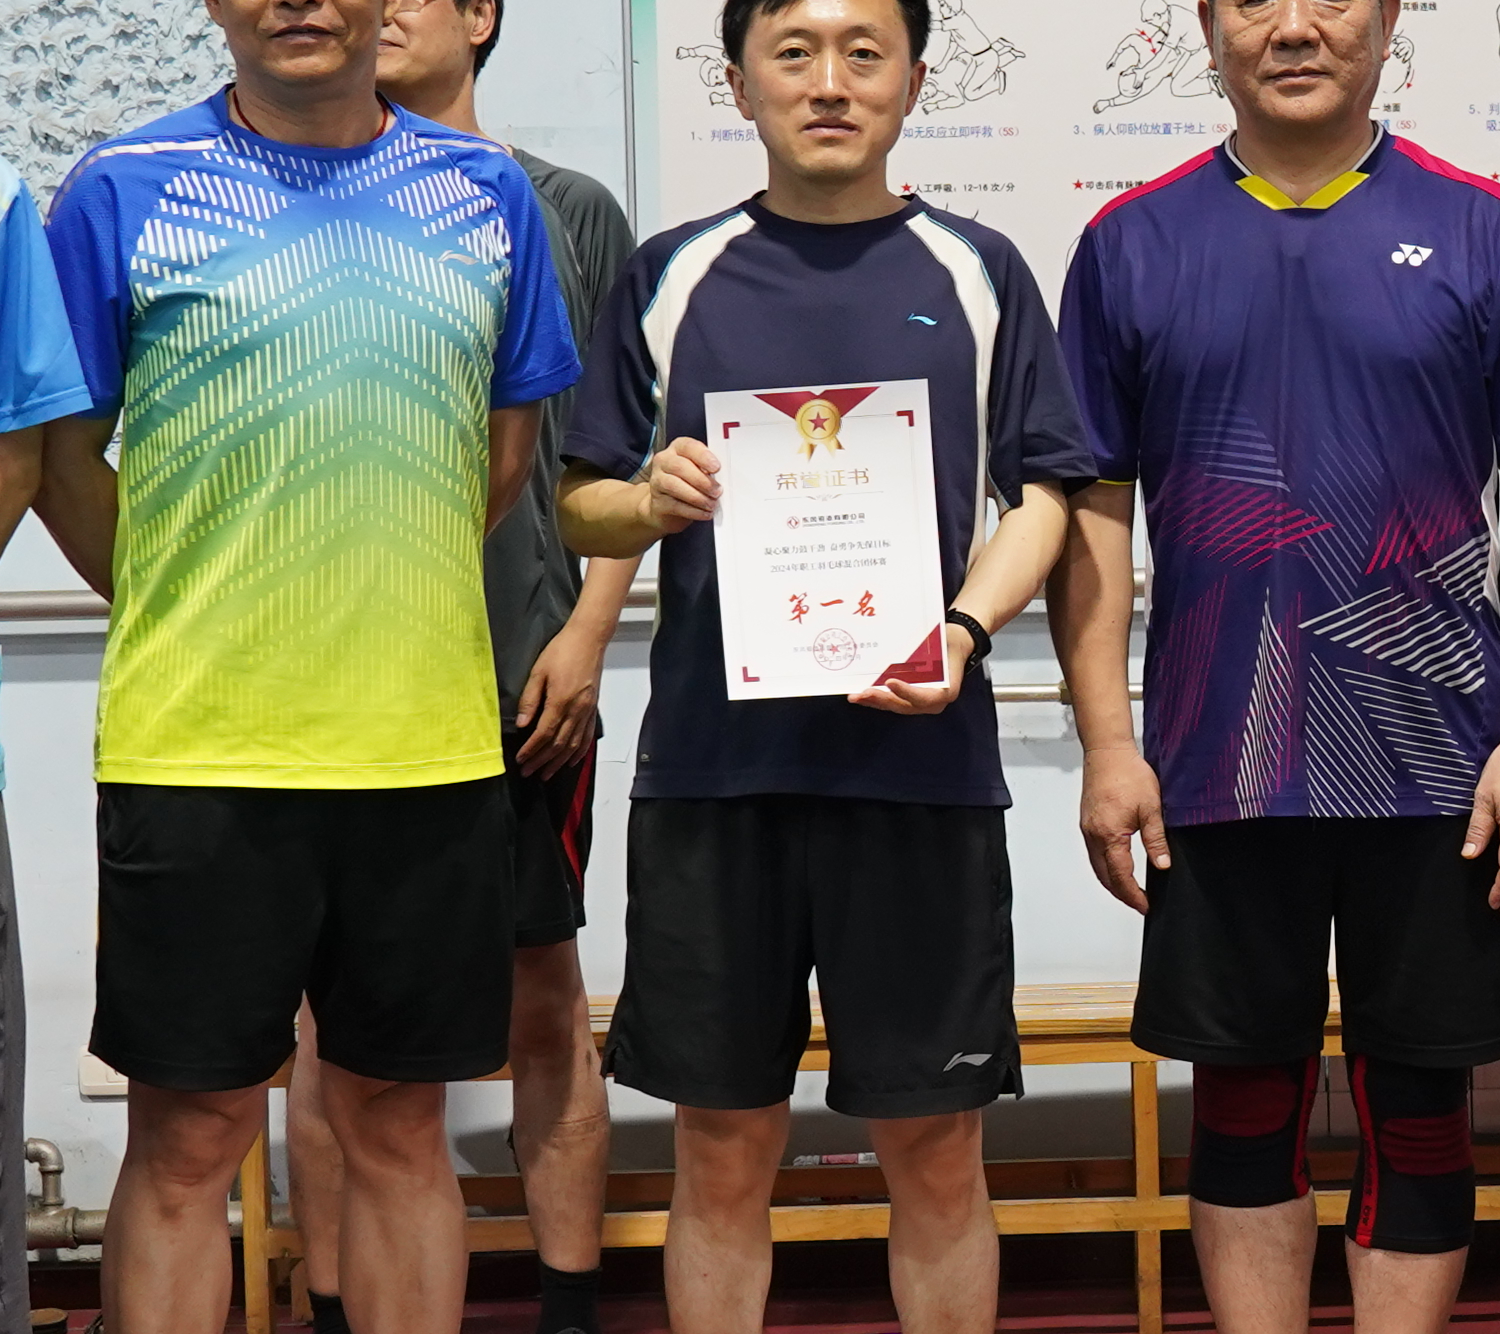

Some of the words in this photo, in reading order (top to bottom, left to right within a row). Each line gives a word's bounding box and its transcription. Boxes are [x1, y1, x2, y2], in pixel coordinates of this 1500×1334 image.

[1382, 102, 1402, 112] 地面
[775, 467, 870, 491] 荣誉证书
[788, 589, 877, 625] 第一名
